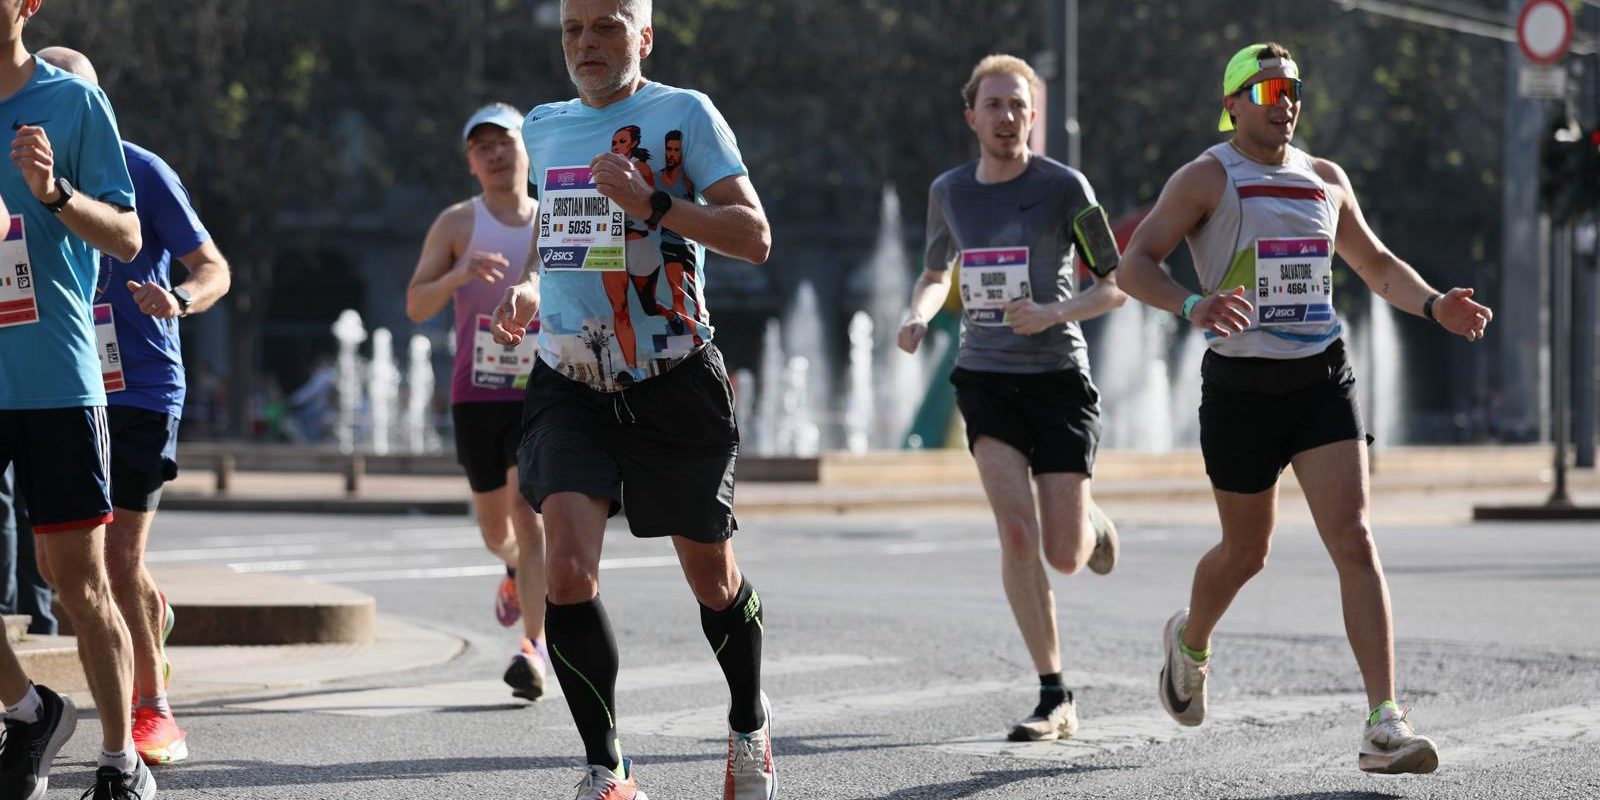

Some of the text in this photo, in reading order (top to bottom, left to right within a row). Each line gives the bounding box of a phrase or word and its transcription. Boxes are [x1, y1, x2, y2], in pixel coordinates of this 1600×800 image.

[553, 196, 610, 217] CRISTIAN MIRCEA
[568, 221, 592, 234] 5035
[552, 251, 574, 260] asics
[1280, 263, 1312, 280] SALVATORE
[1275, 308, 1296, 317] asics
